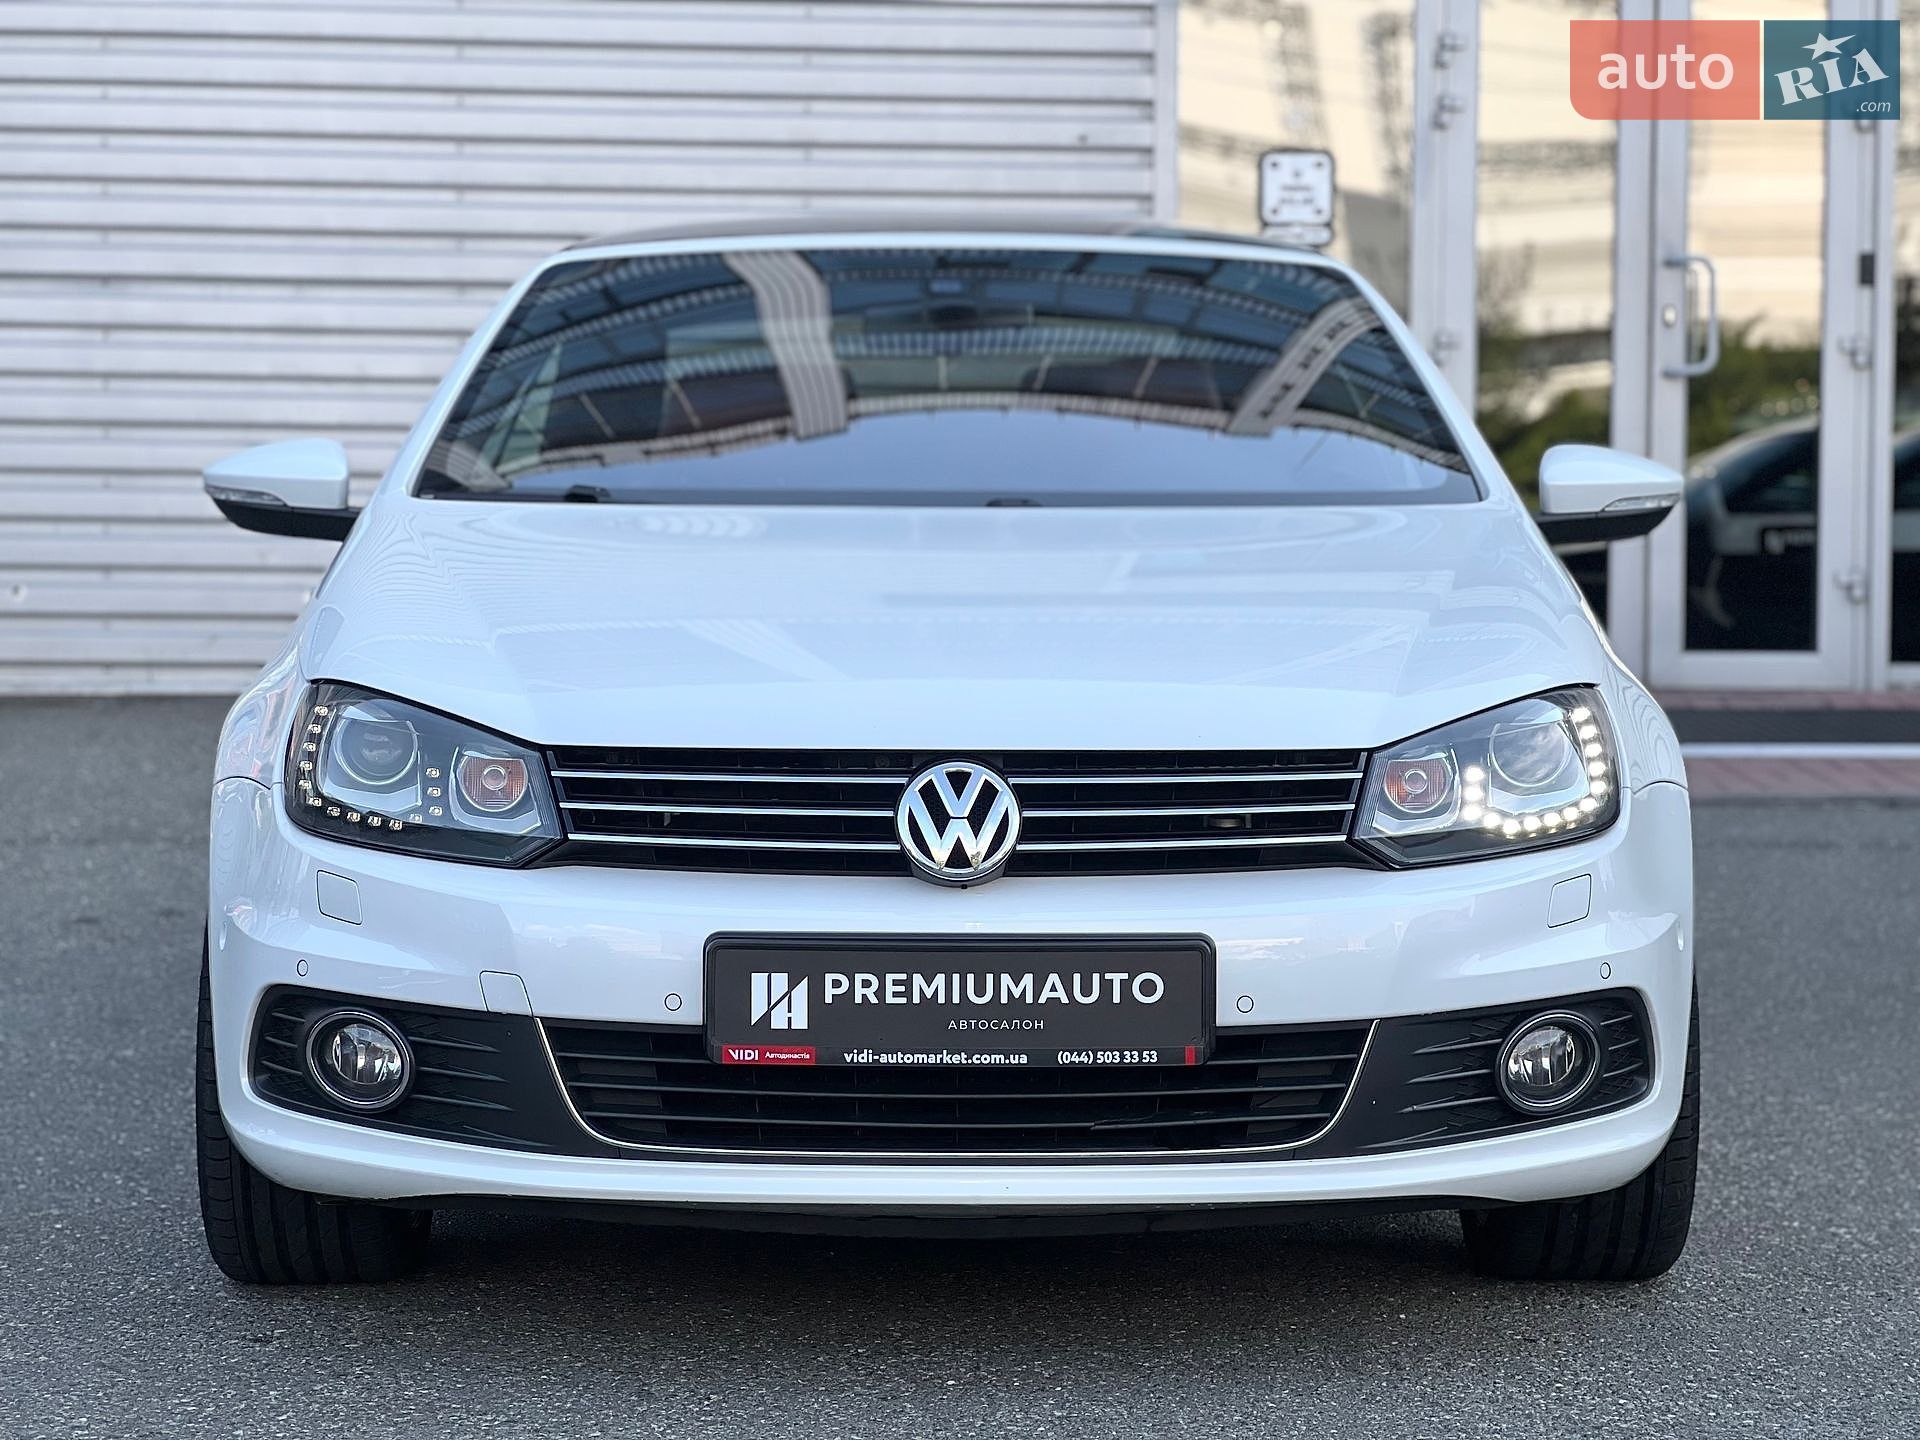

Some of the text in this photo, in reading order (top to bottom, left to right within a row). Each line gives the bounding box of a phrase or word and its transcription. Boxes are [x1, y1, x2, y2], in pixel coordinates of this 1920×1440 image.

[823, 972, 1165, 1004] PREMIUMAUTO
[947, 1018, 1045, 1030] АВТОСАЛОН
[728, 1049, 759, 1061] VIDI
[844, 1049, 1028, 1064] vidi-automarket.com.ua
[1057, 1050, 1158, 1065] (044) 503 33 53
